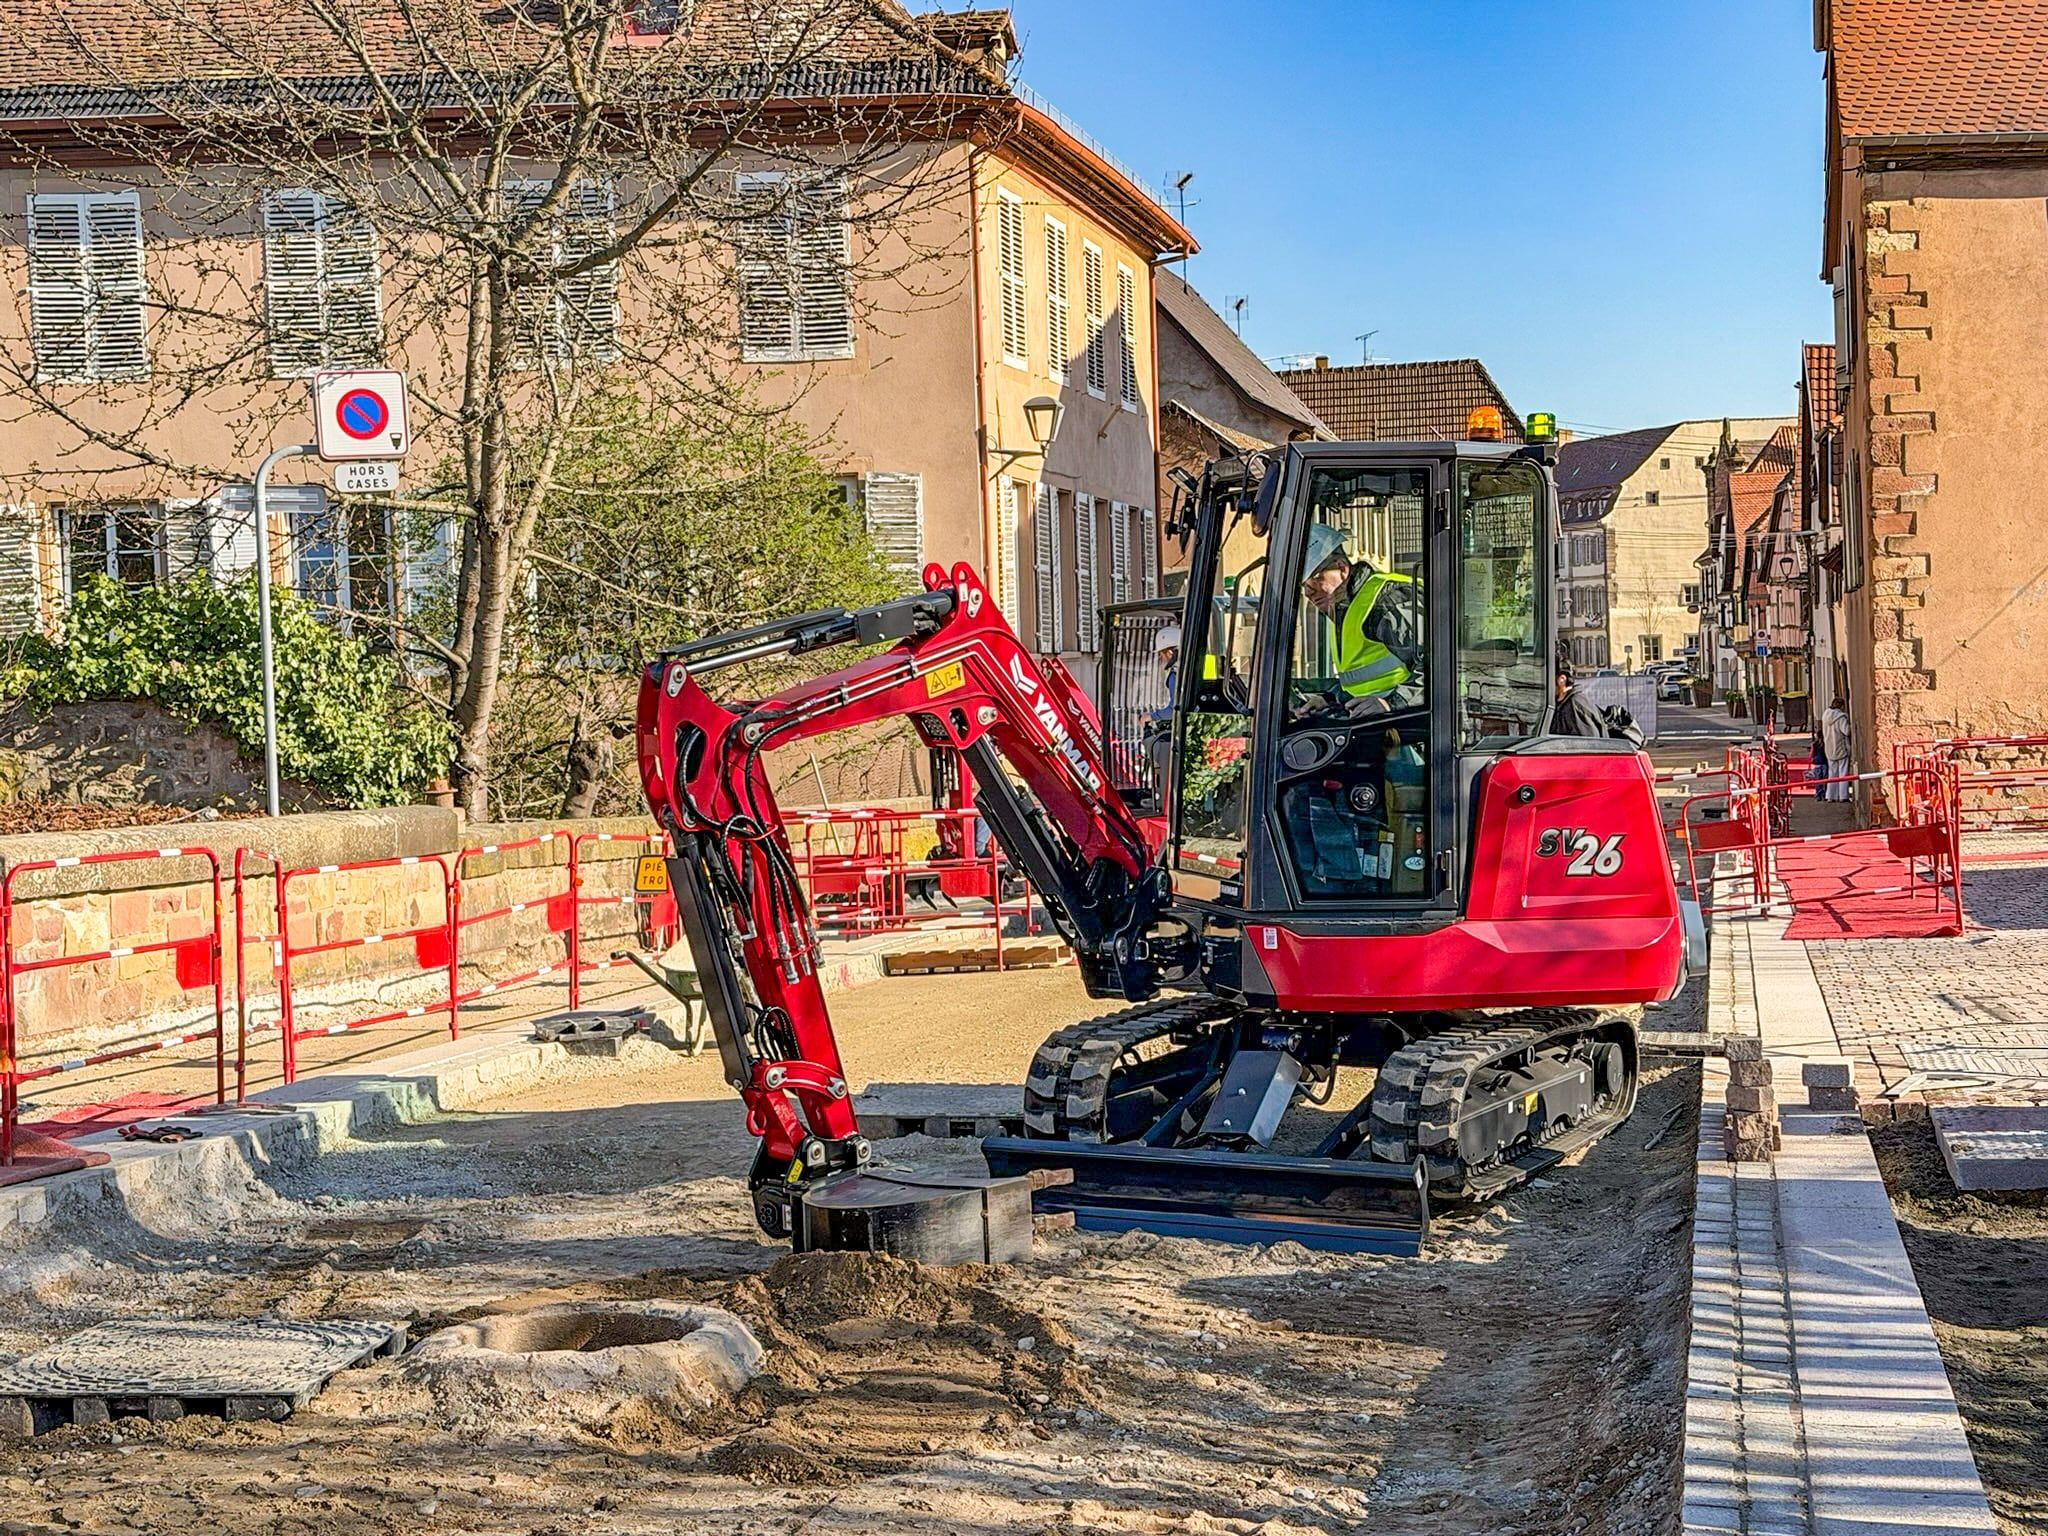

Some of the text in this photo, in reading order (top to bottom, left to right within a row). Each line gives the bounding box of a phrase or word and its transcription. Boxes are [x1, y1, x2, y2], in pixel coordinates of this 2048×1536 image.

[349, 466, 385, 476] HORS
[347, 478, 389, 489] CASES
[1079, 716, 1102, 751] YANM
